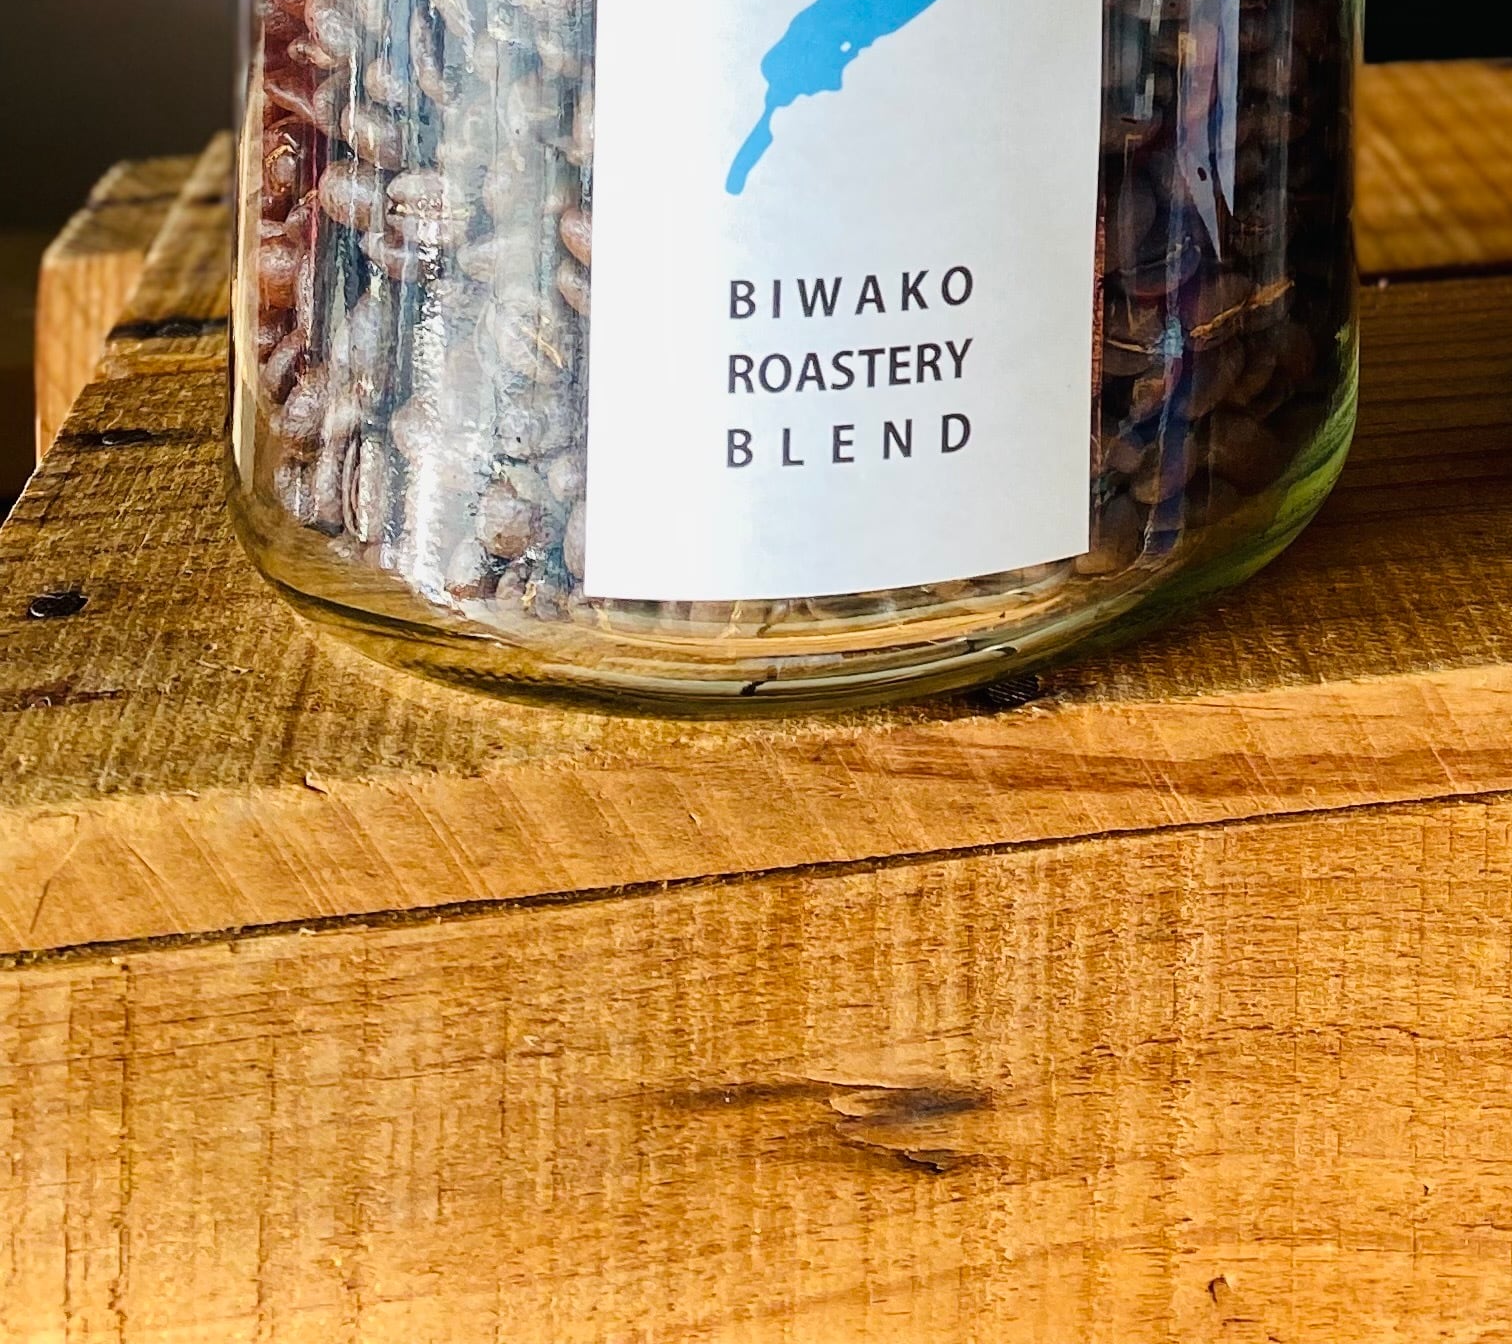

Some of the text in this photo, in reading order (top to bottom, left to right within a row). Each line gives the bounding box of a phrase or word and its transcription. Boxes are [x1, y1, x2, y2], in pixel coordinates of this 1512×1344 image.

[729, 265, 974, 320] BIWAKO
[728, 337, 974, 394] ROASTERY
[727, 413, 972, 468] BLEND
